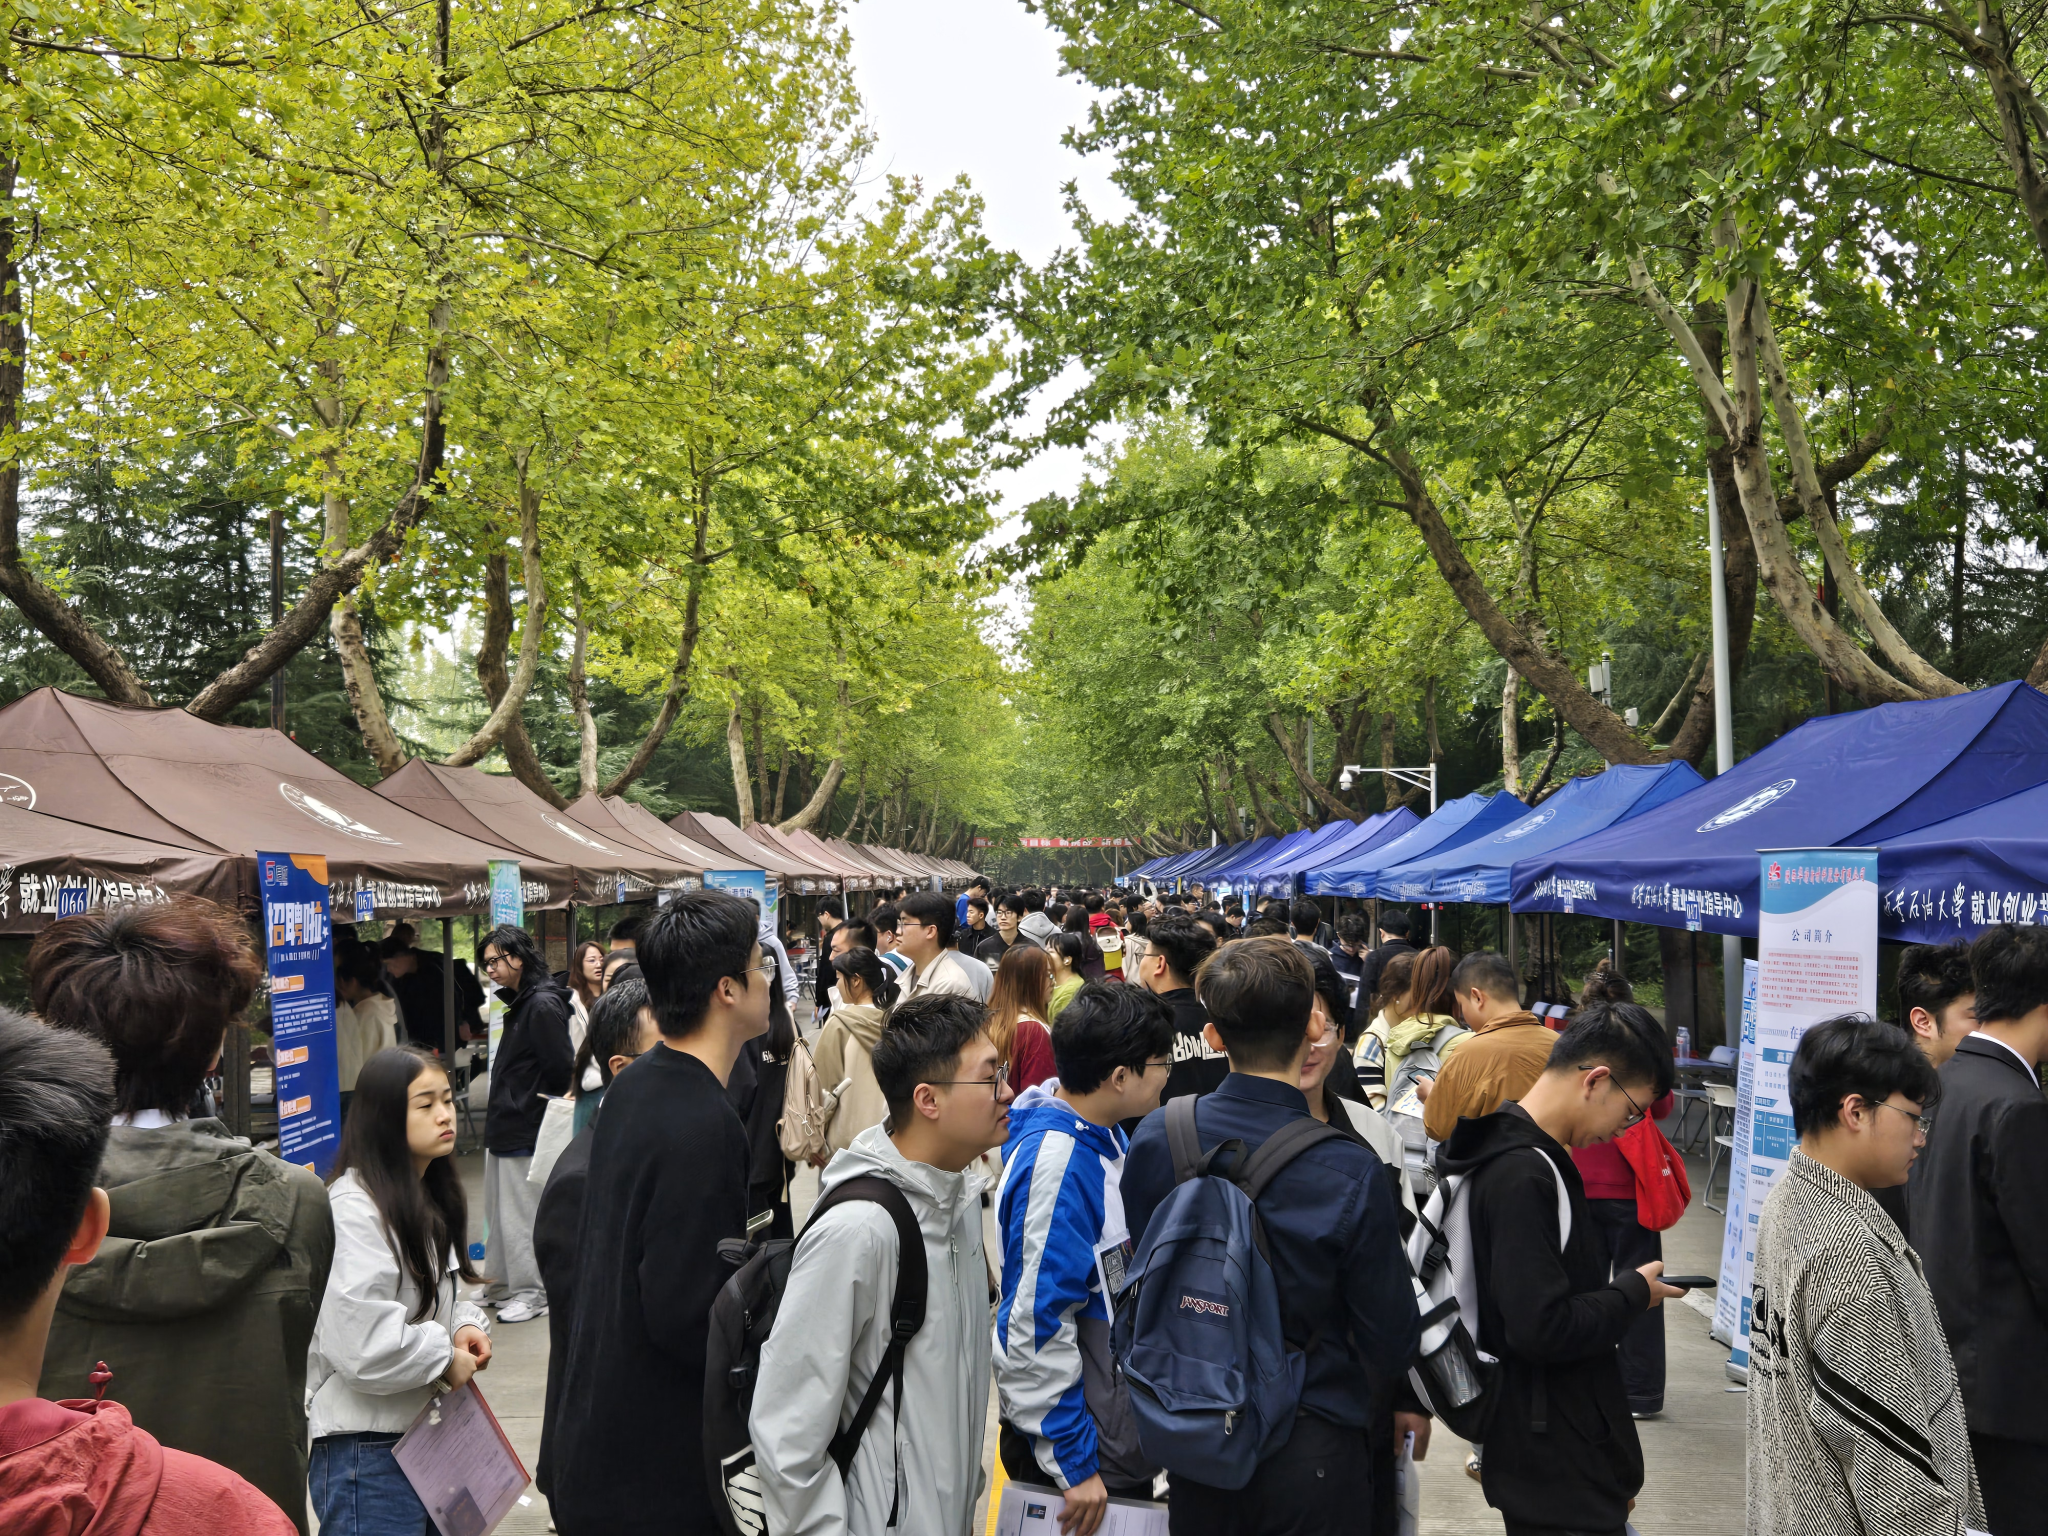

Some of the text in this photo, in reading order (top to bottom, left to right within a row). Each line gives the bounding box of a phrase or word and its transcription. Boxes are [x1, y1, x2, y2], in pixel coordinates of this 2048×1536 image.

[61, 891, 84, 915] 066
[358, 893, 371, 911] 067
[268, 901, 323, 948] 招聘啦
[1791, 928, 1833, 944] 公司简介
[1180, 1295, 1230, 1317] JANSPORT
